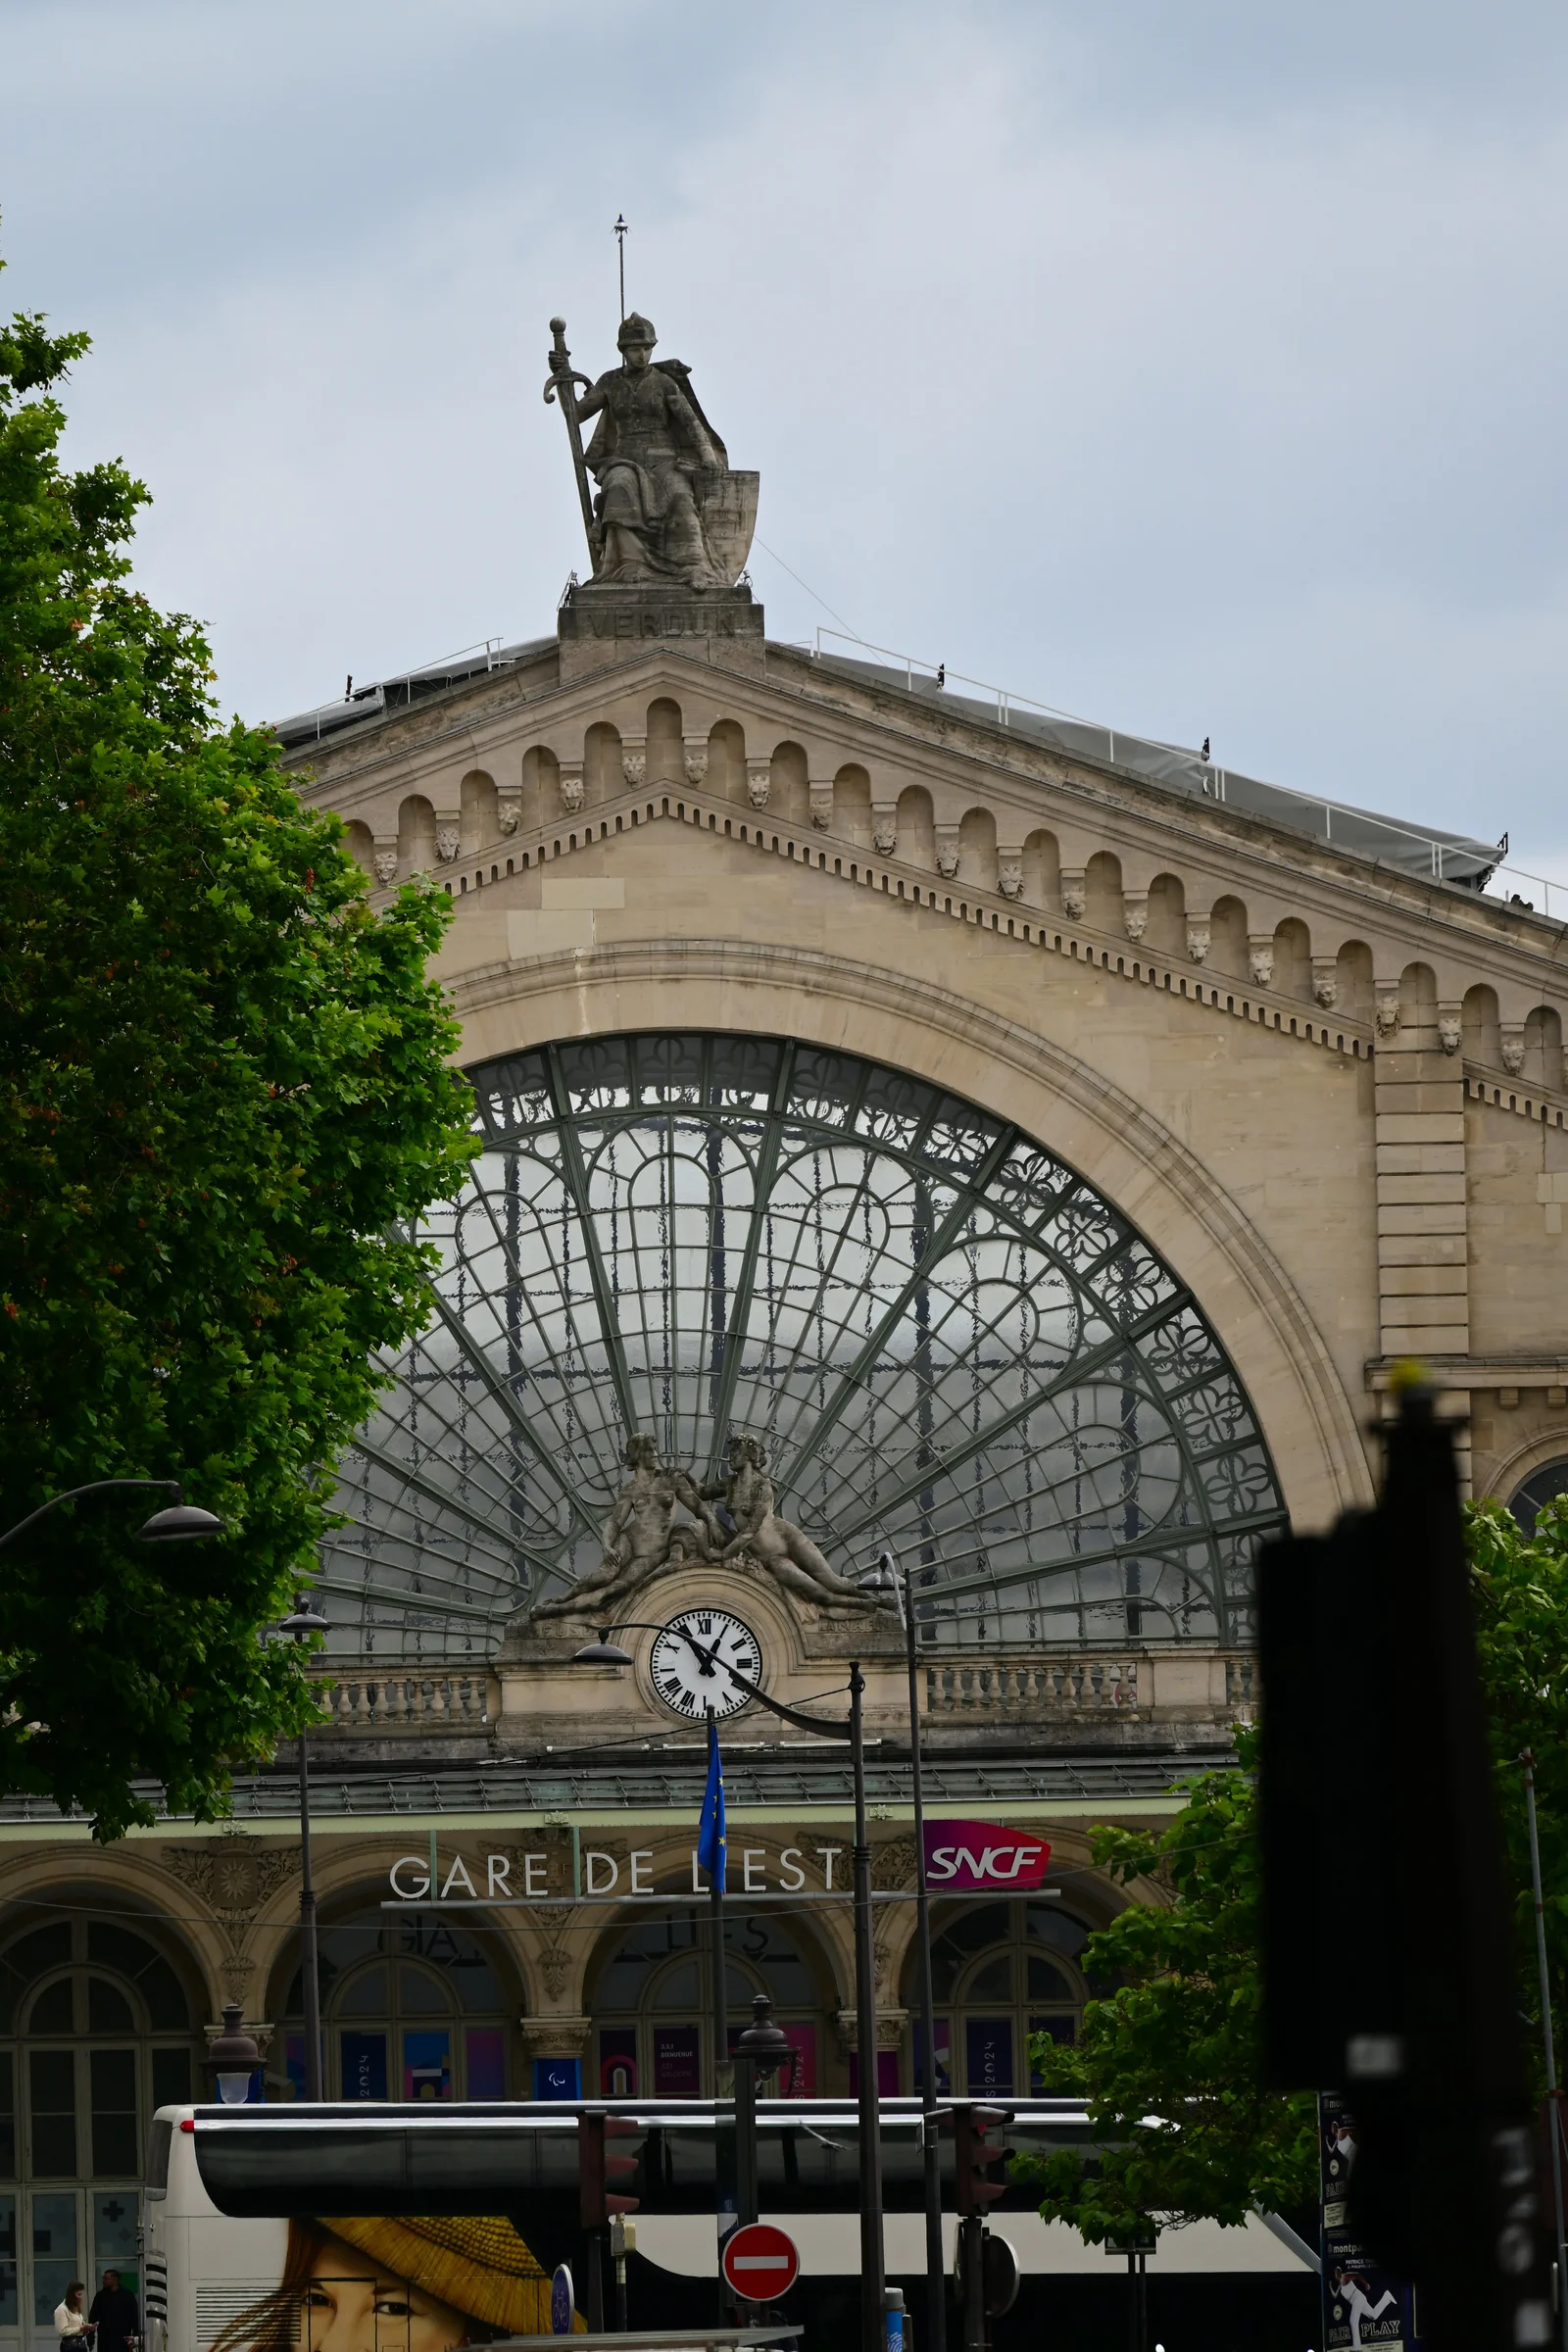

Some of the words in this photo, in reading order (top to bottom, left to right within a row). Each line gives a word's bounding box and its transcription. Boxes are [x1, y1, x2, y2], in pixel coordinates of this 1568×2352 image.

[588, 612, 734, 638] VERDUN
[389, 1853, 548, 1899] GARE
[586, 1851, 655, 1894] DE
[926, 1846, 1043, 1880] SNCF
[359, 2055, 369, 2097] 2024
[984, 2041, 996, 2083] 2024
[1360, 2320, 1400, 2338] PLAY
